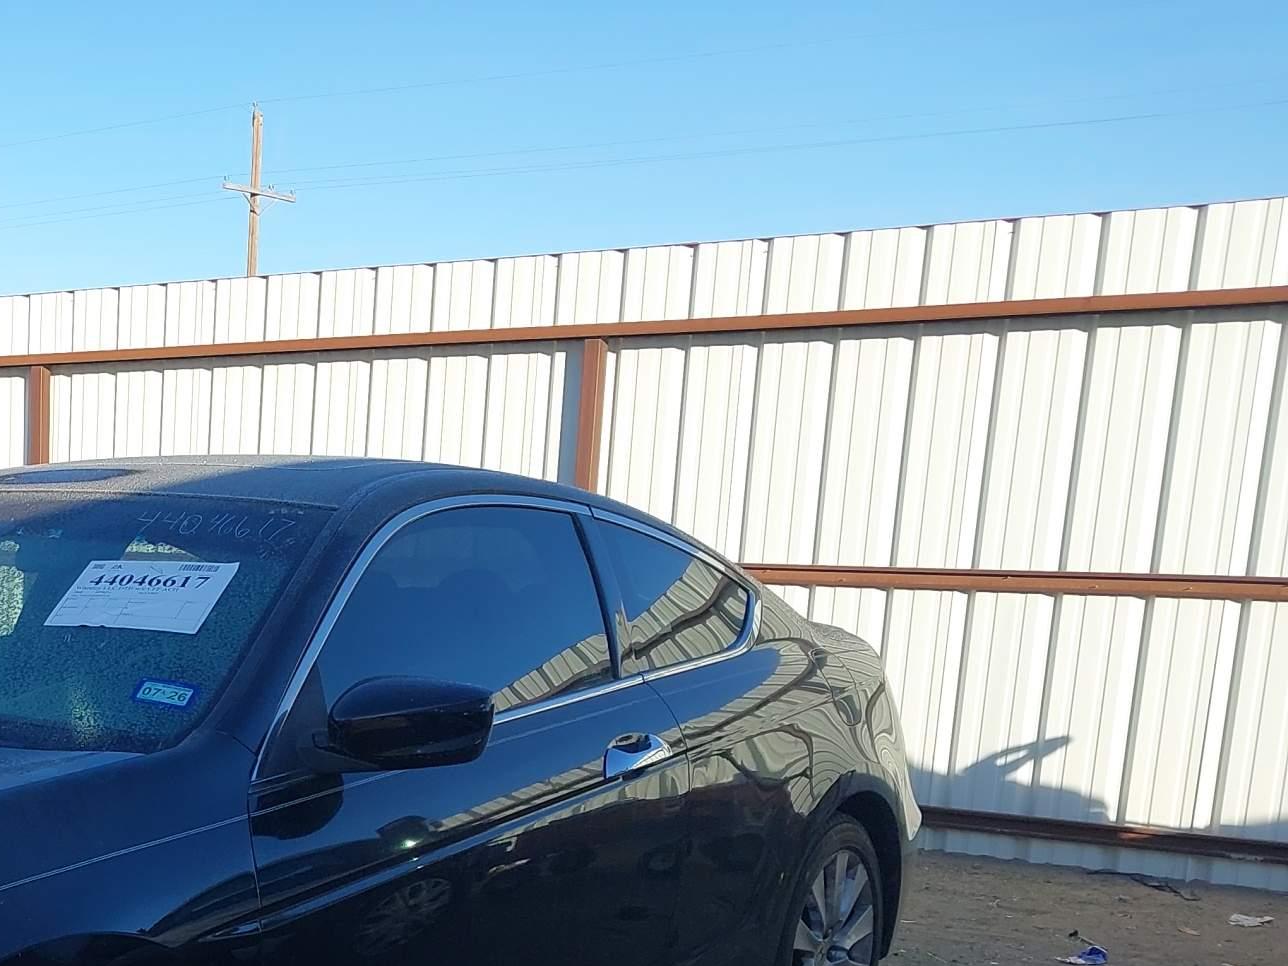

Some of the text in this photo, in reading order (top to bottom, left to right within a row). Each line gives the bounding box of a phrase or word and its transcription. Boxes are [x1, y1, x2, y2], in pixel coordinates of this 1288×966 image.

[89, 573, 211, 589] 44046617
[142, 686, 188, 702] 07 26
